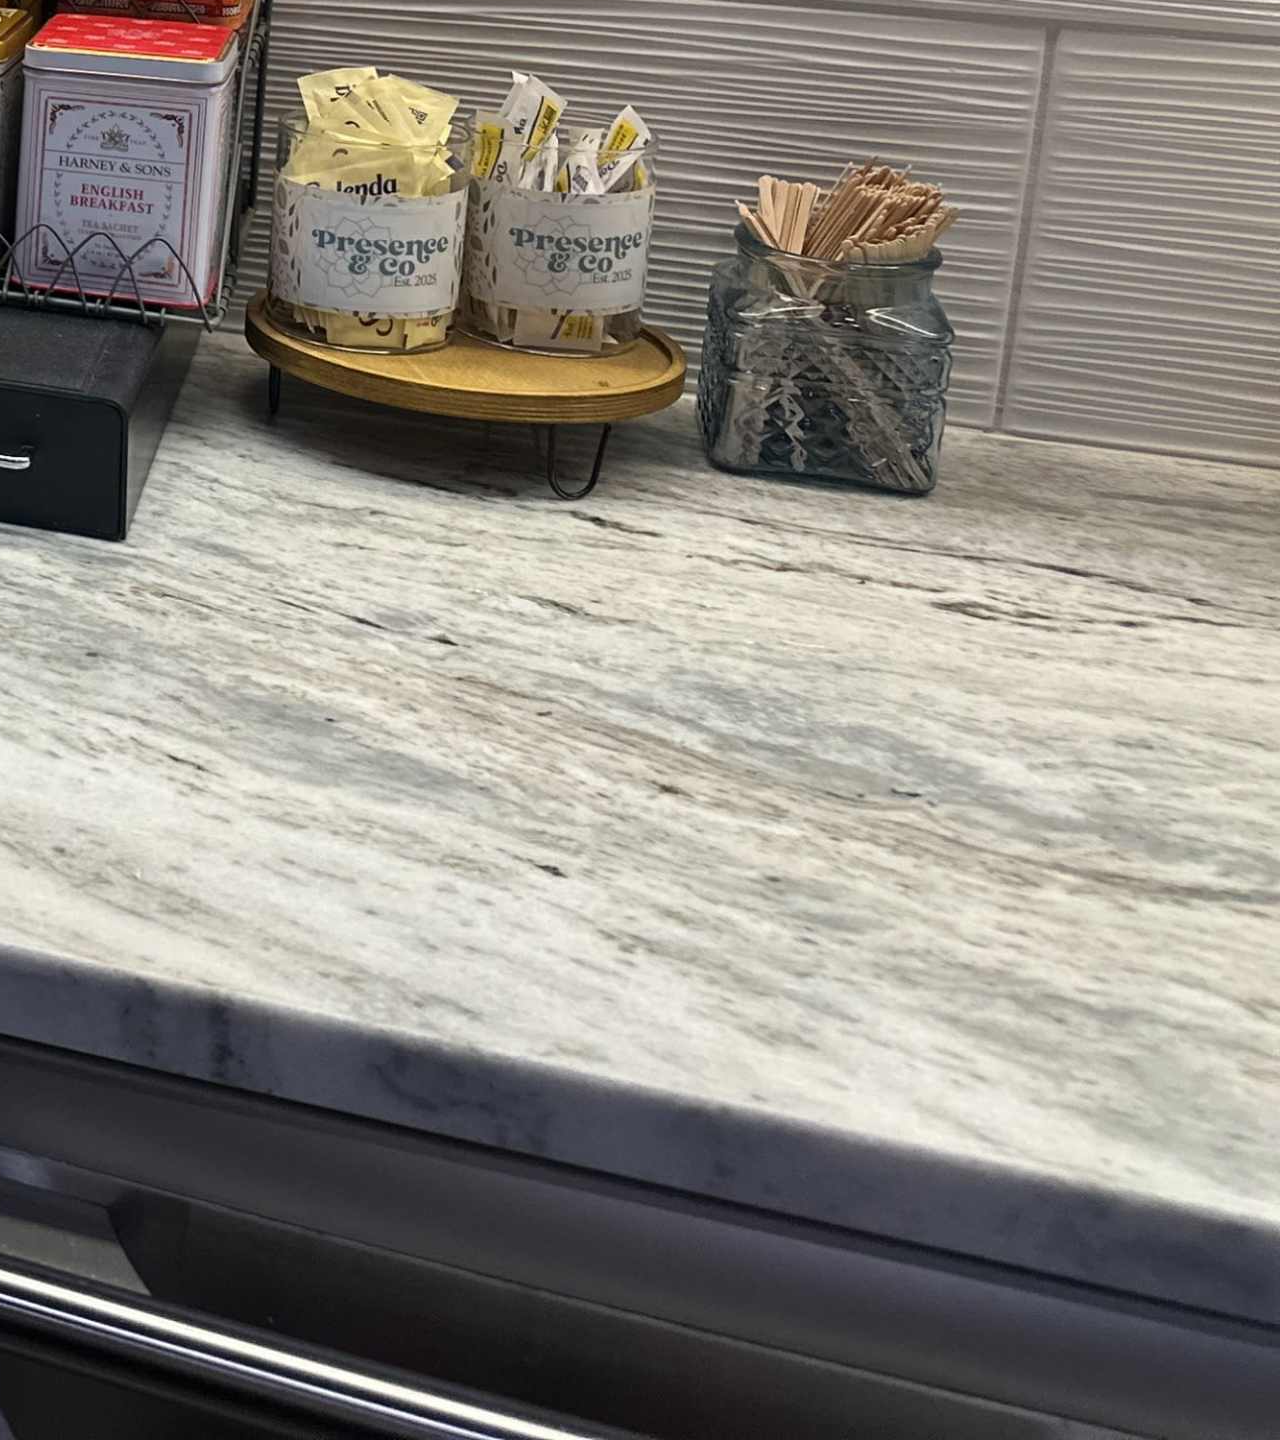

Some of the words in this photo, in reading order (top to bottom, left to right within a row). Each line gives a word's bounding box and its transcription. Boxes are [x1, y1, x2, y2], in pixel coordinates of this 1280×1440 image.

[58, 155, 116, 172] HARNEY
[119, 162, 131, 174] &
[135, 164, 172, 178] SONS
[81, 182, 145, 200] ENGLISH
[70, 195, 155, 215] BREAKFAST
[311, 228, 449, 264] Presence
[508, 227, 643, 260] Presence
[347, 254, 372, 276] &
[547, 252, 570, 273] &
[592, 274, 610, 284] Est.
[611, 269, 633, 284] 2025
